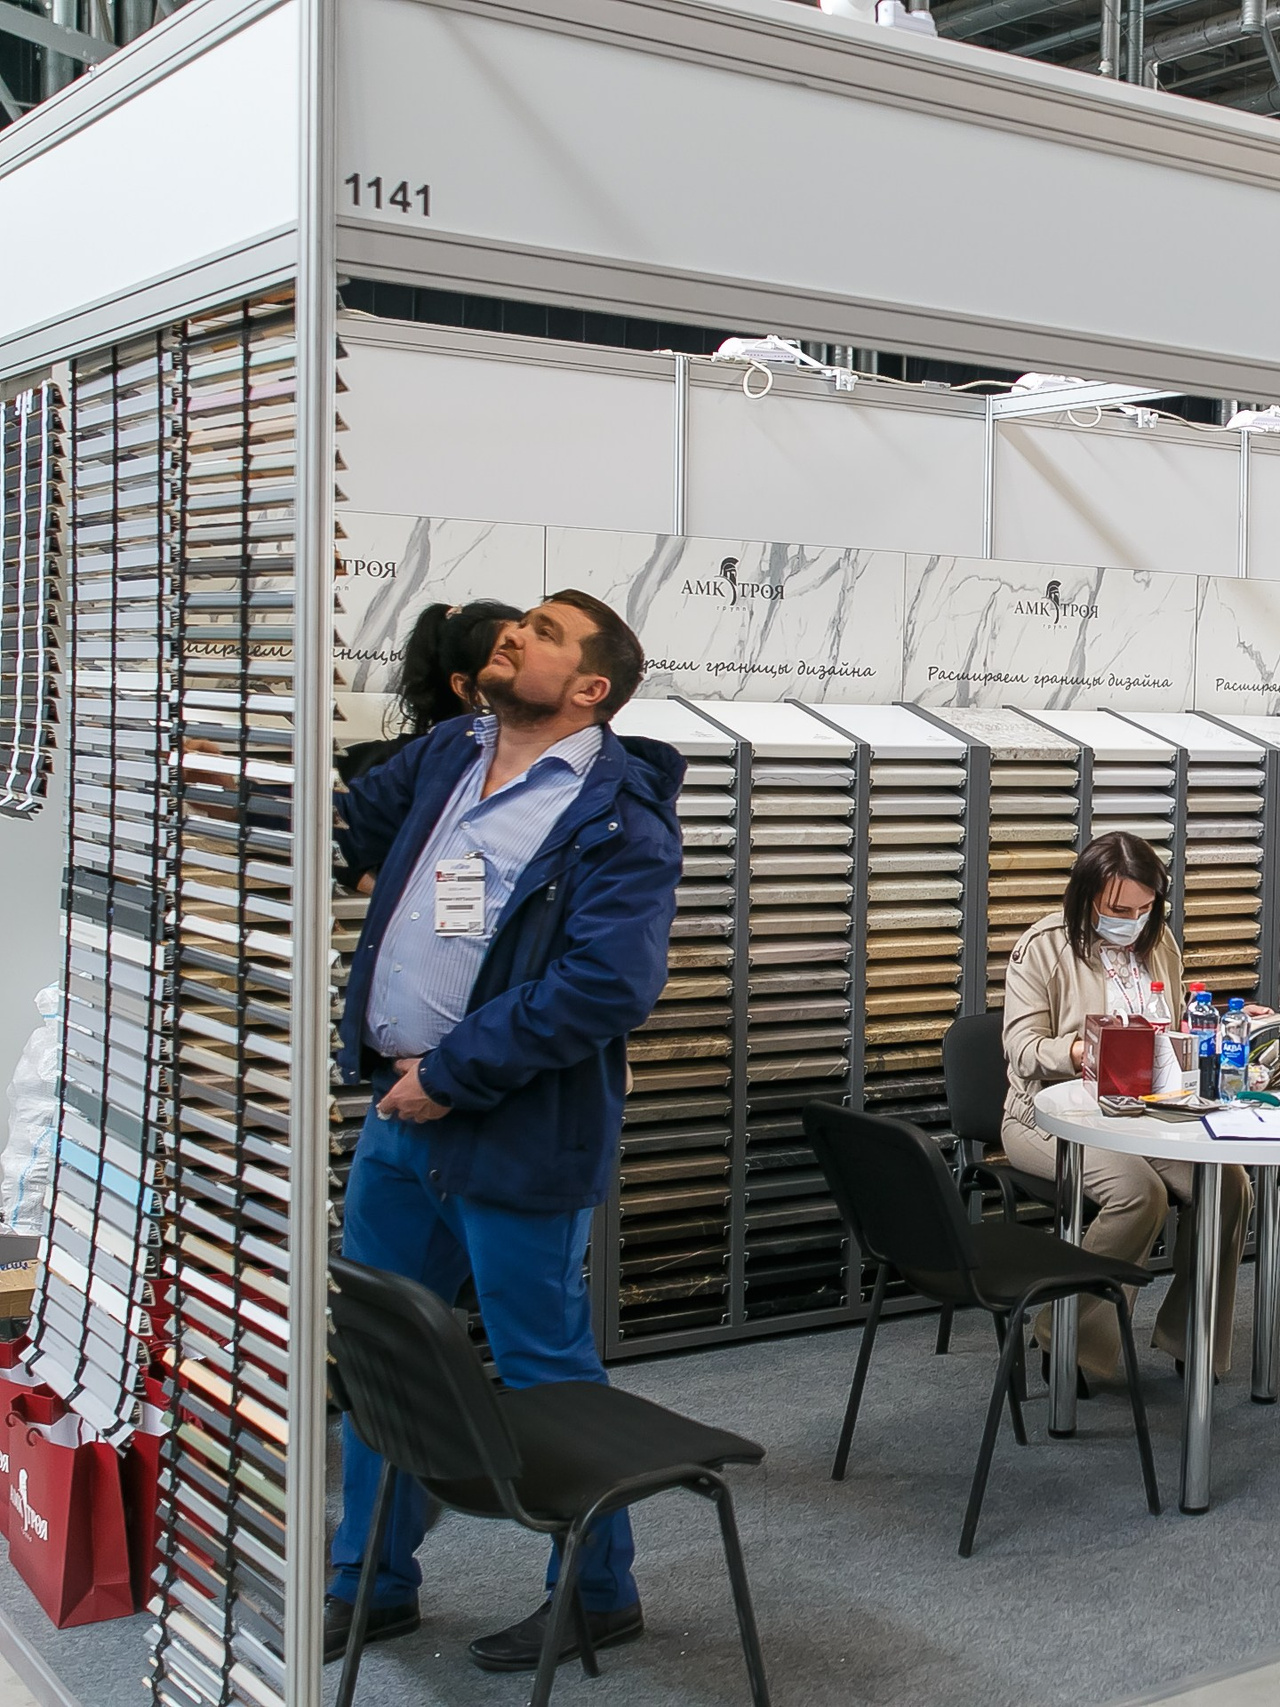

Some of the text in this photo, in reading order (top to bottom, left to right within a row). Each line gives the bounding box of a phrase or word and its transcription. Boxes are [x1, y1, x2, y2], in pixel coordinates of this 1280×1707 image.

[344, 172, 431, 217] 1141
[680, 579, 785, 601] АМК ТРОЯ
[1014, 601, 1099, 619] АМК ТРОЯ
[706, 660, 793, 678] границы
[797, 660, 876, 679] дизайна
[928, 666, 1173, 691] Расширяем границы дизайна
